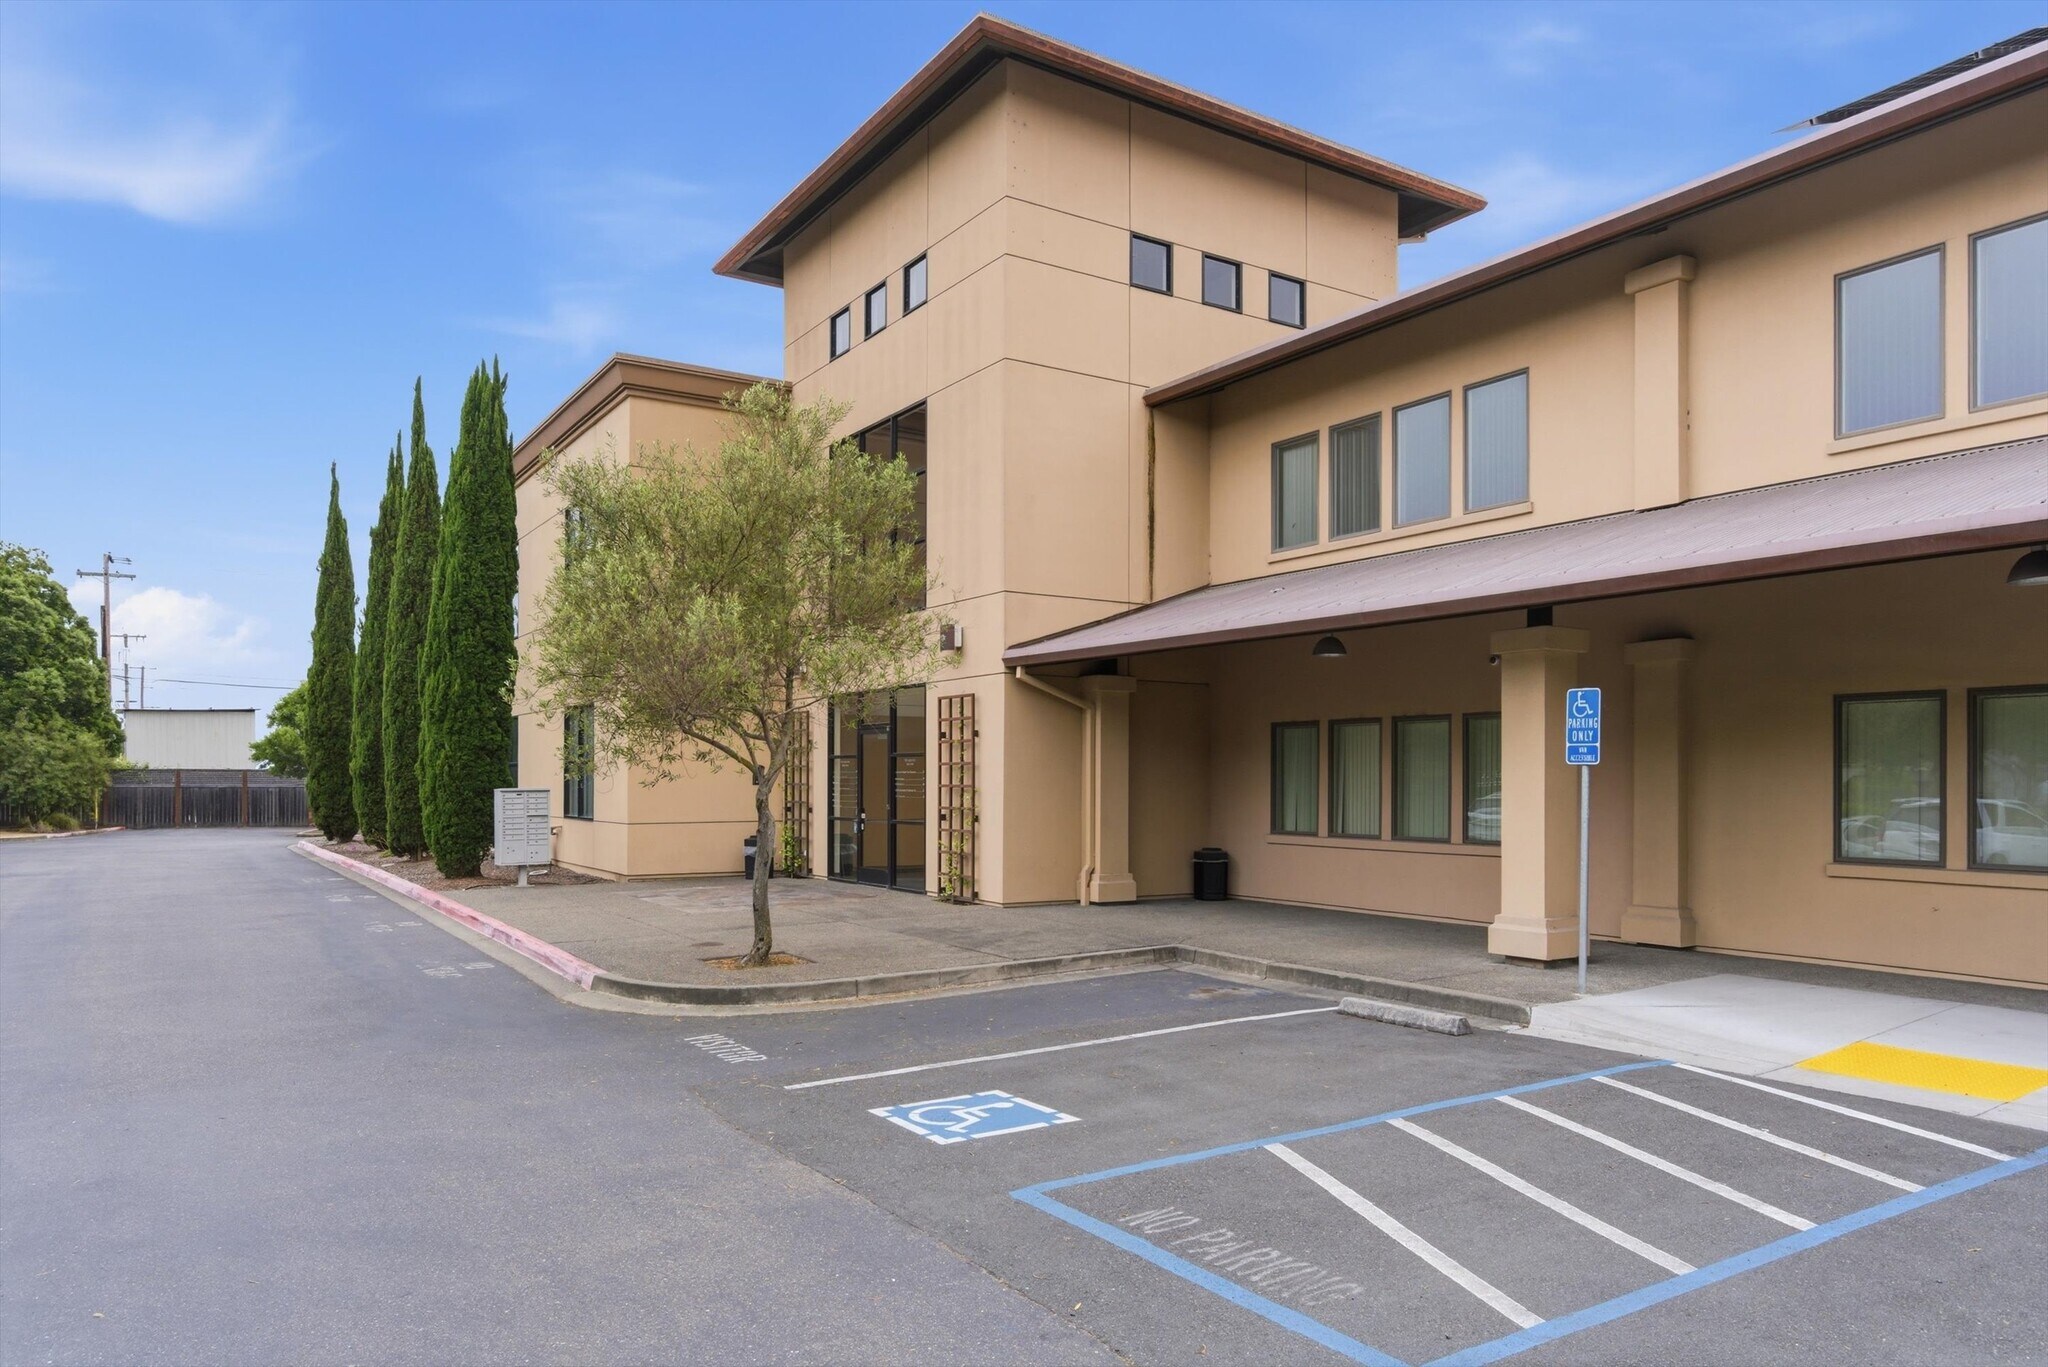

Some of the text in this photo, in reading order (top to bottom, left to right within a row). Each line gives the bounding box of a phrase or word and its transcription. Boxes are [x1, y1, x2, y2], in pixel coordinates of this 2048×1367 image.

[1568, 717, 1598, 729] PARKING
[1572, 730, 1594, 742] ONLY
[683, 1033, 768, 1064] VISITOR
[1118, 1206, 1365, 1306] NO PARKING
